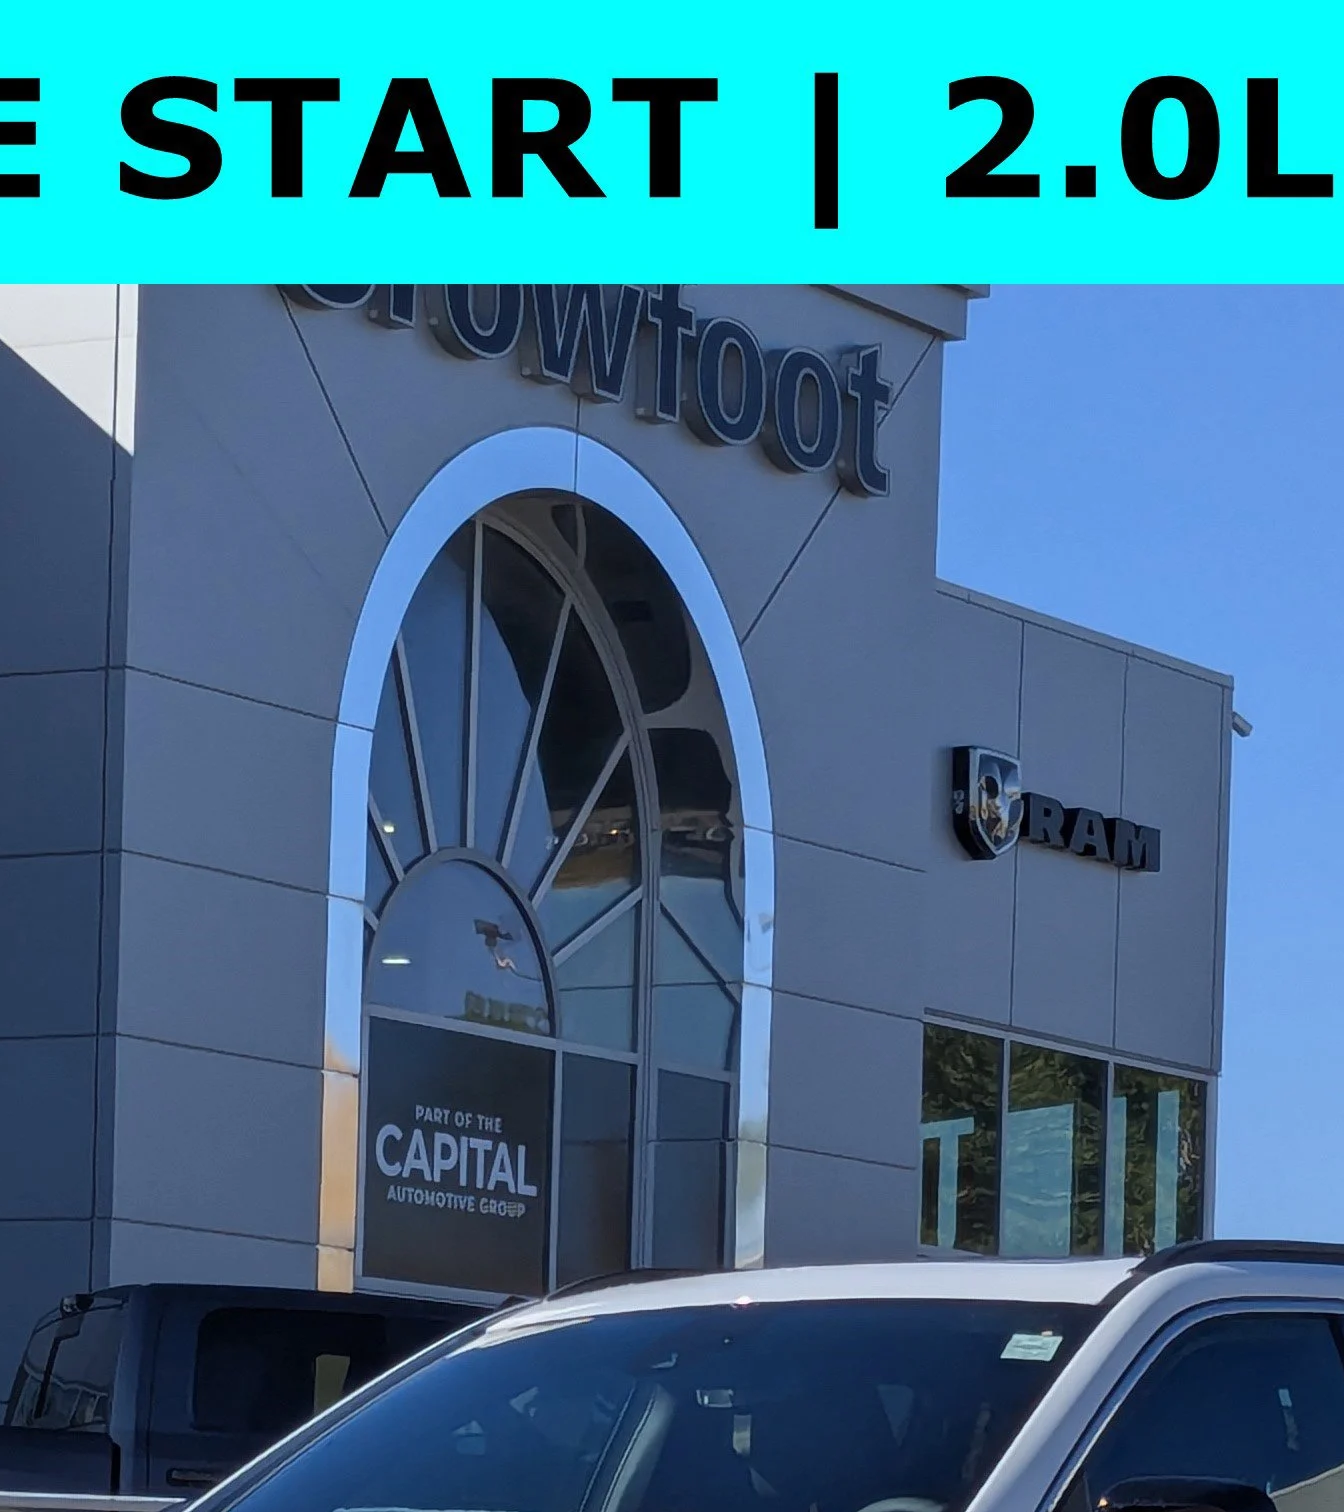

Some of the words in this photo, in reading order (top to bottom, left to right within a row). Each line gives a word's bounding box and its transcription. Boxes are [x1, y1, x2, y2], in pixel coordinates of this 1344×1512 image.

[1022, 792, 1160, 872] RAM
[414, 1105, 451, 1125] PART
[455, 1112, 473, 1128] OF
[477, 1115, 502, 1133] THE
[375, 1124, 538, 1197] CAPITAL
[387, 1185, 476, 1213] AUTOMOTIVE
